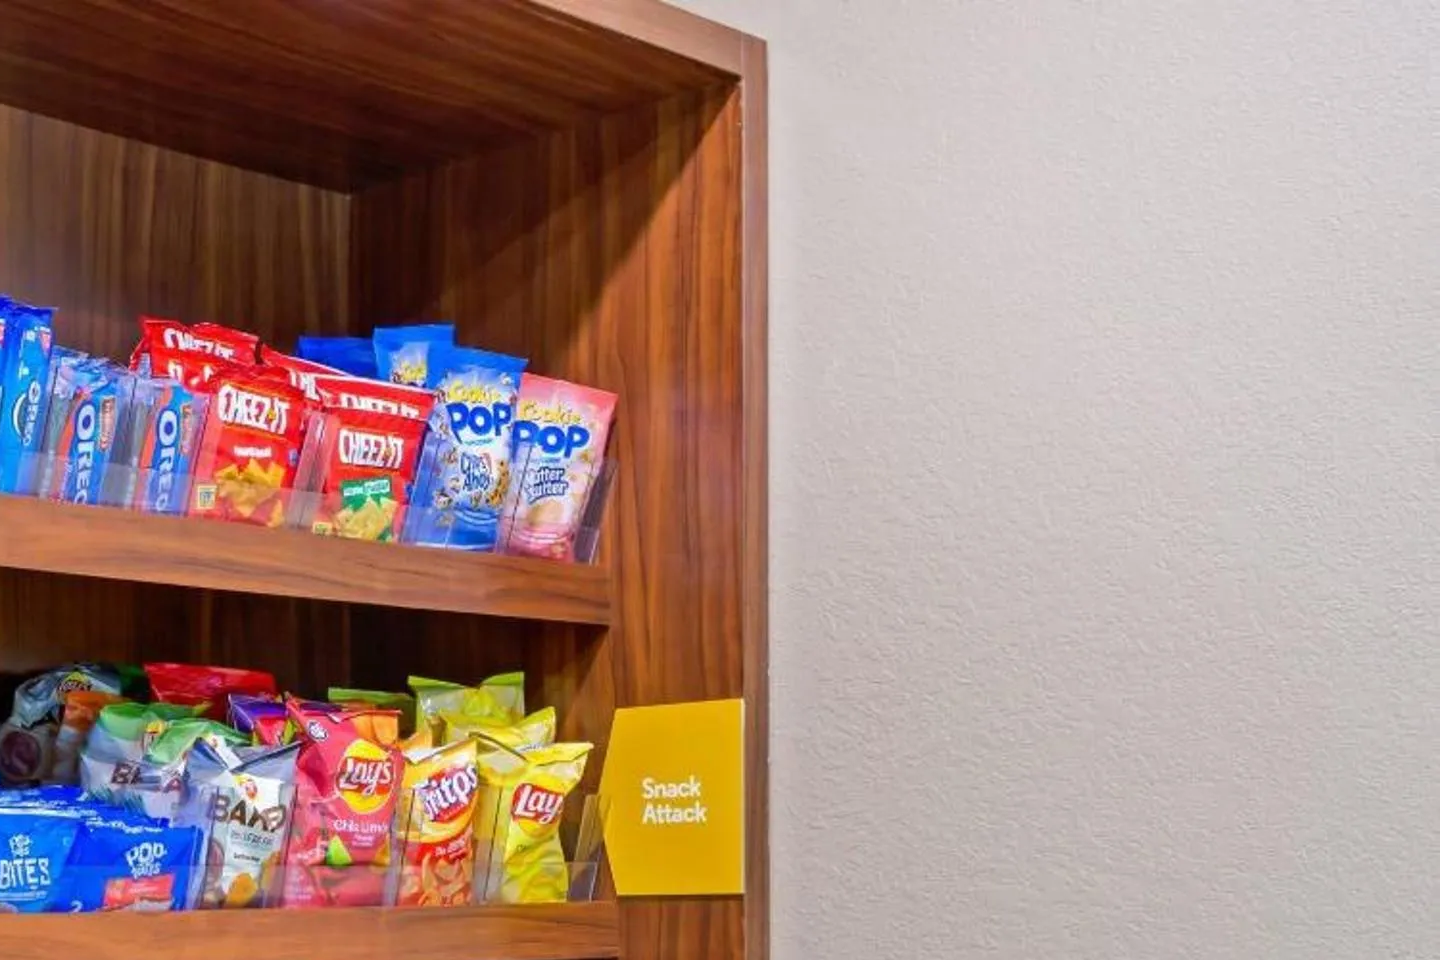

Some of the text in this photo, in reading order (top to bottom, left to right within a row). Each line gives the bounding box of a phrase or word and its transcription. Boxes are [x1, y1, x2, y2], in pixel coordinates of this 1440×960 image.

[21, 381, 41, 447] OREO
[445, 402, 512, 444] POP
[155, 408, 179, 511] OREO
[513, 420, 590, 460] POP
[339, 758, 393, 795] Lay's
[642, 777, 702, 798] Snack
[642, 801, 708, 824] Attack
